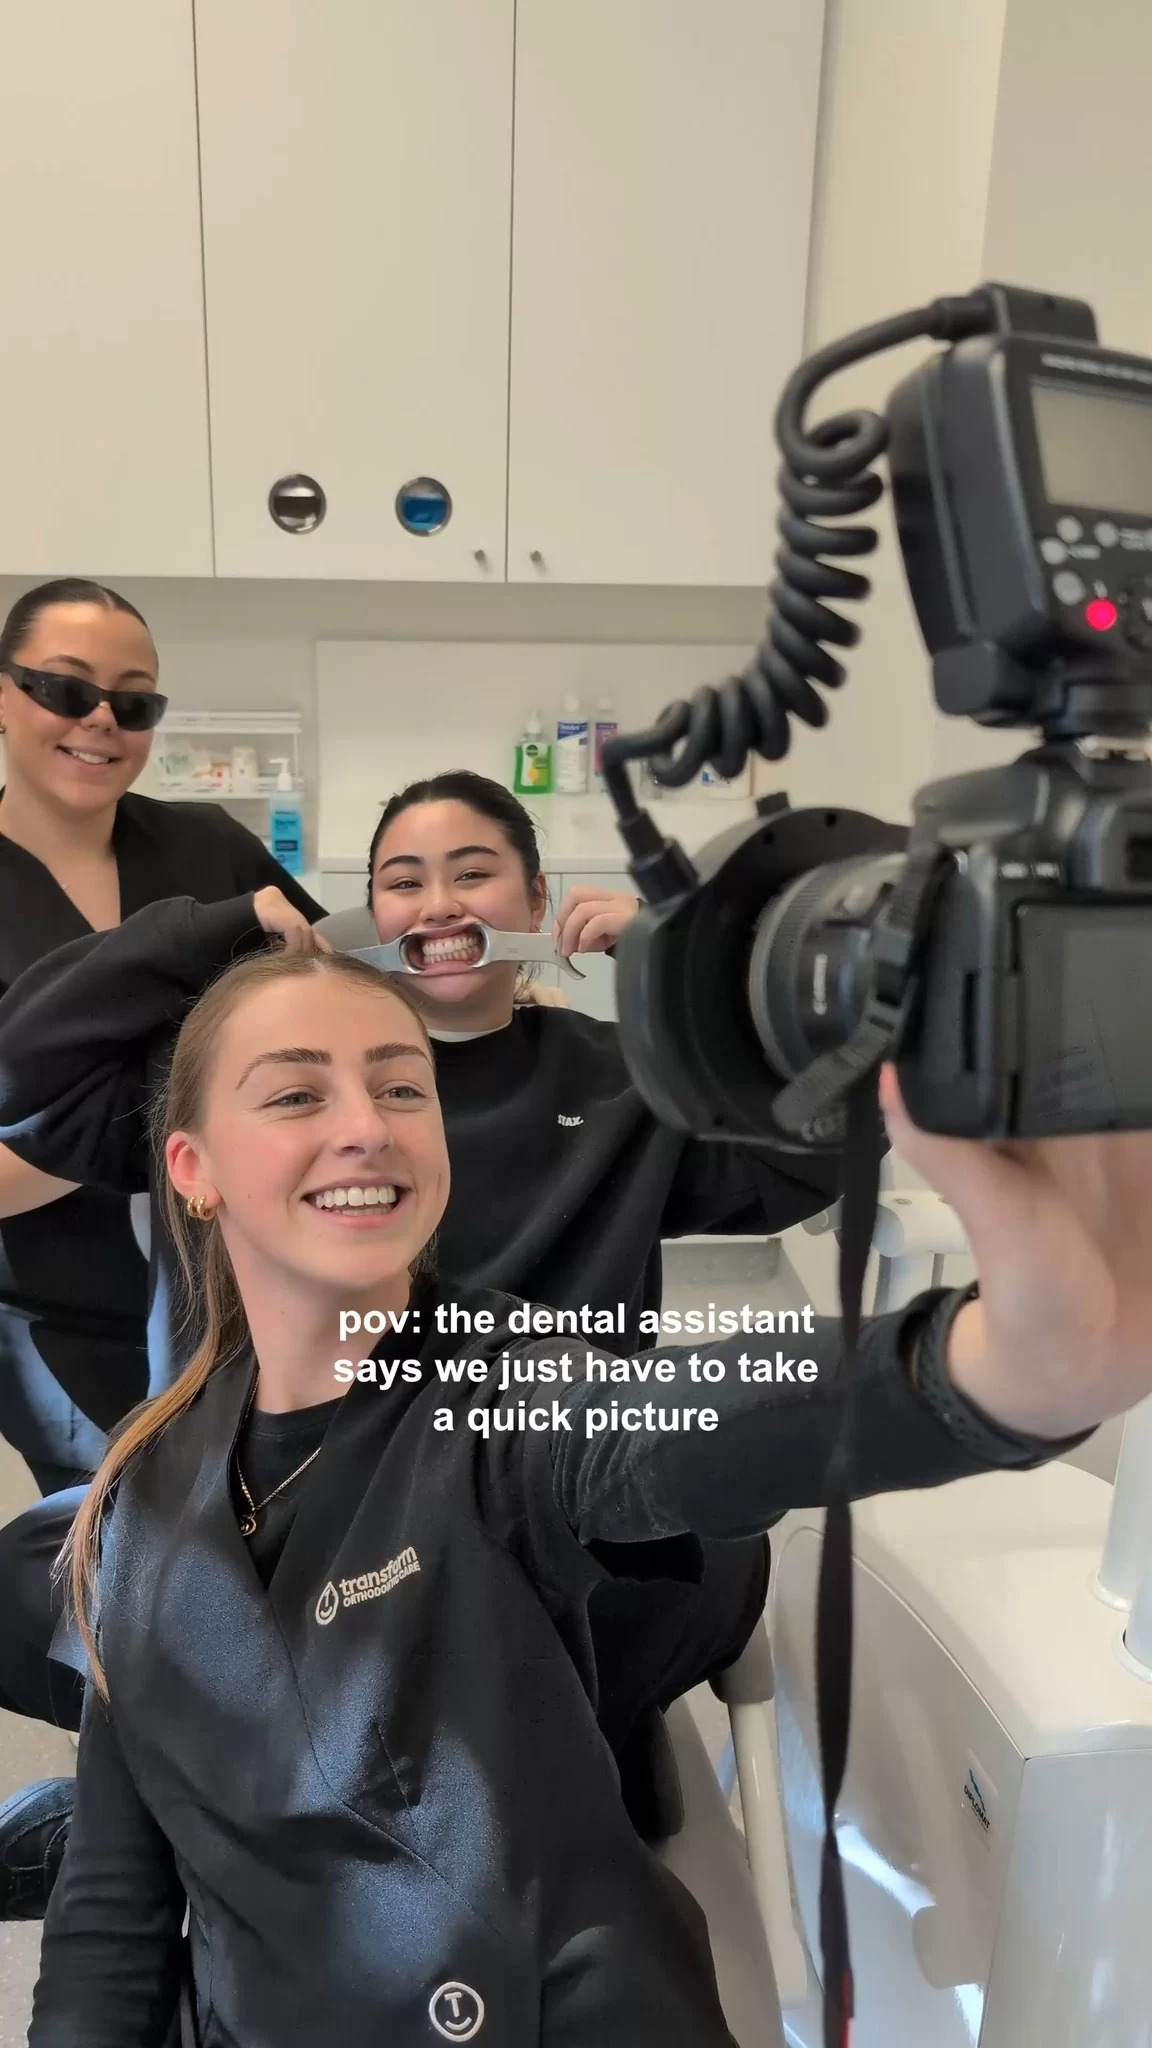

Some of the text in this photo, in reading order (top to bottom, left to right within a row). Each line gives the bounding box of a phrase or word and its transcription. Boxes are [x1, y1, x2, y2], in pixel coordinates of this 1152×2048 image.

[339, 1547, 418, 1596] transform
[343, 1561, 421, 1607] ORTHODONTIC CARE
[963, 1784, 991, 1829] DIPLOMAT
